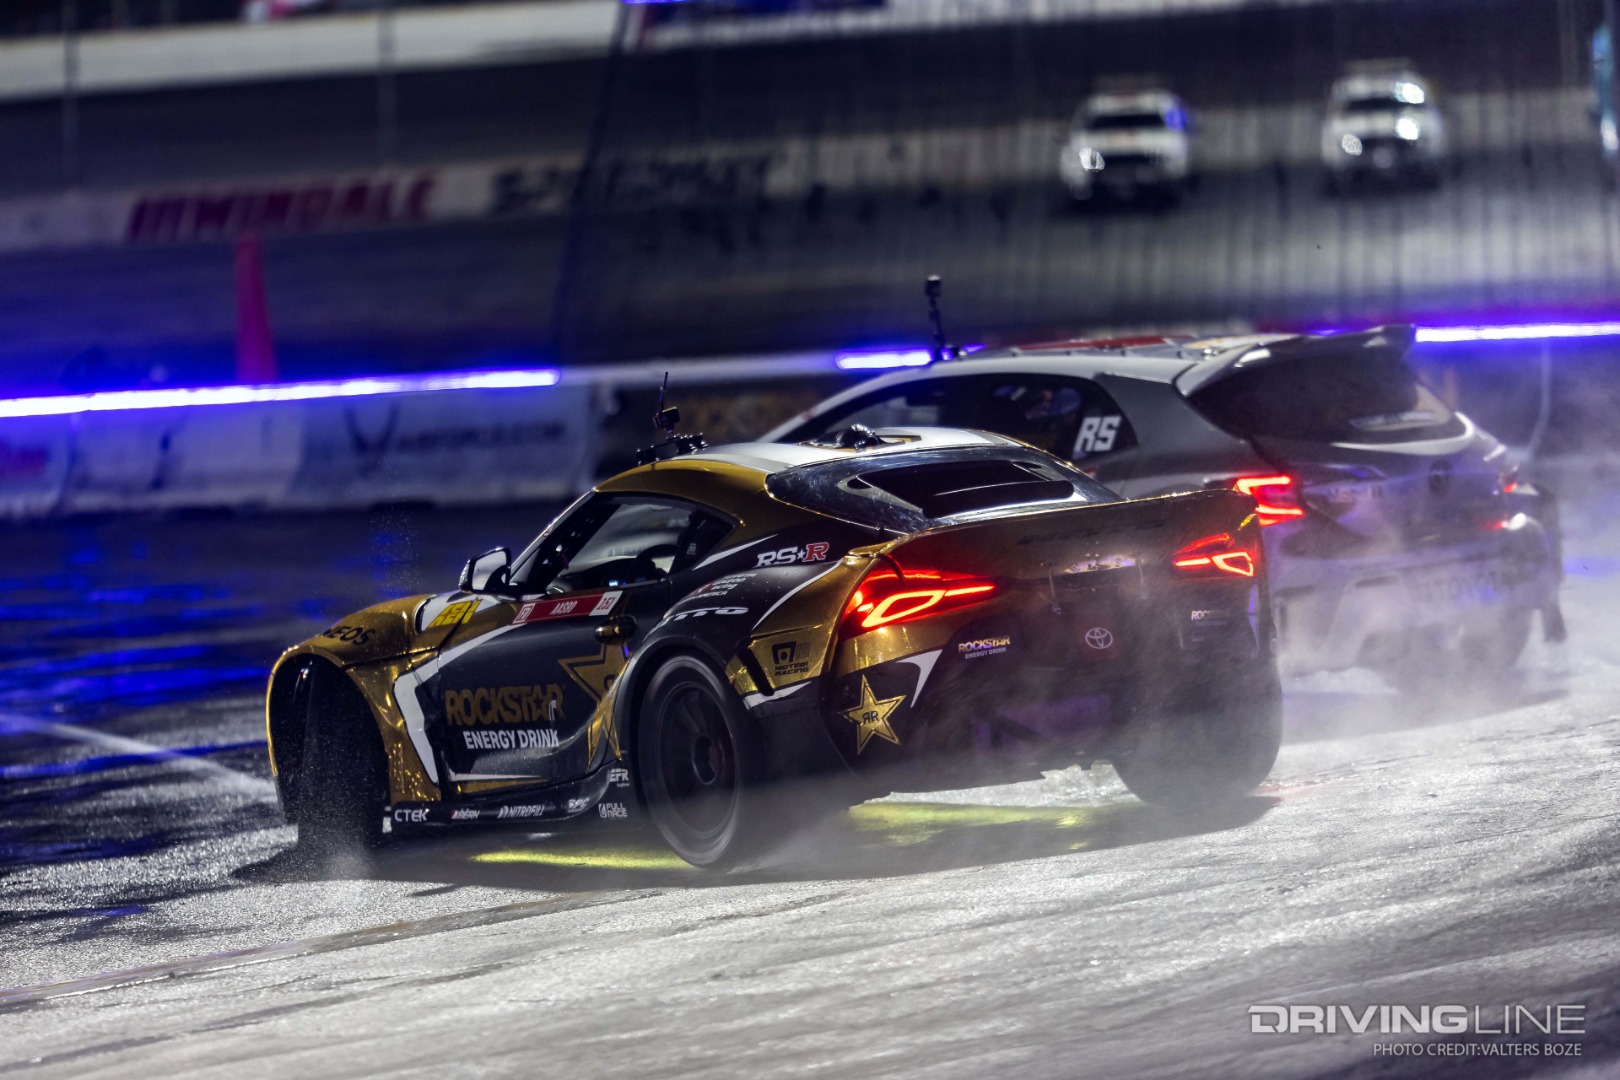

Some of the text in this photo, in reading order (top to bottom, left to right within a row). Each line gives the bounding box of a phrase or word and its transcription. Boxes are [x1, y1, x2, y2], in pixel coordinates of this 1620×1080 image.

[1072, 415, 1122, 459] RS
[958, 636, 1011, 653] ROCKSTAR
[444, 683, 566, 726] ROCKSTAR
[462, 728, 560, 750] ENERGY DRINK
[394, 808, 431, 823] CTEK
